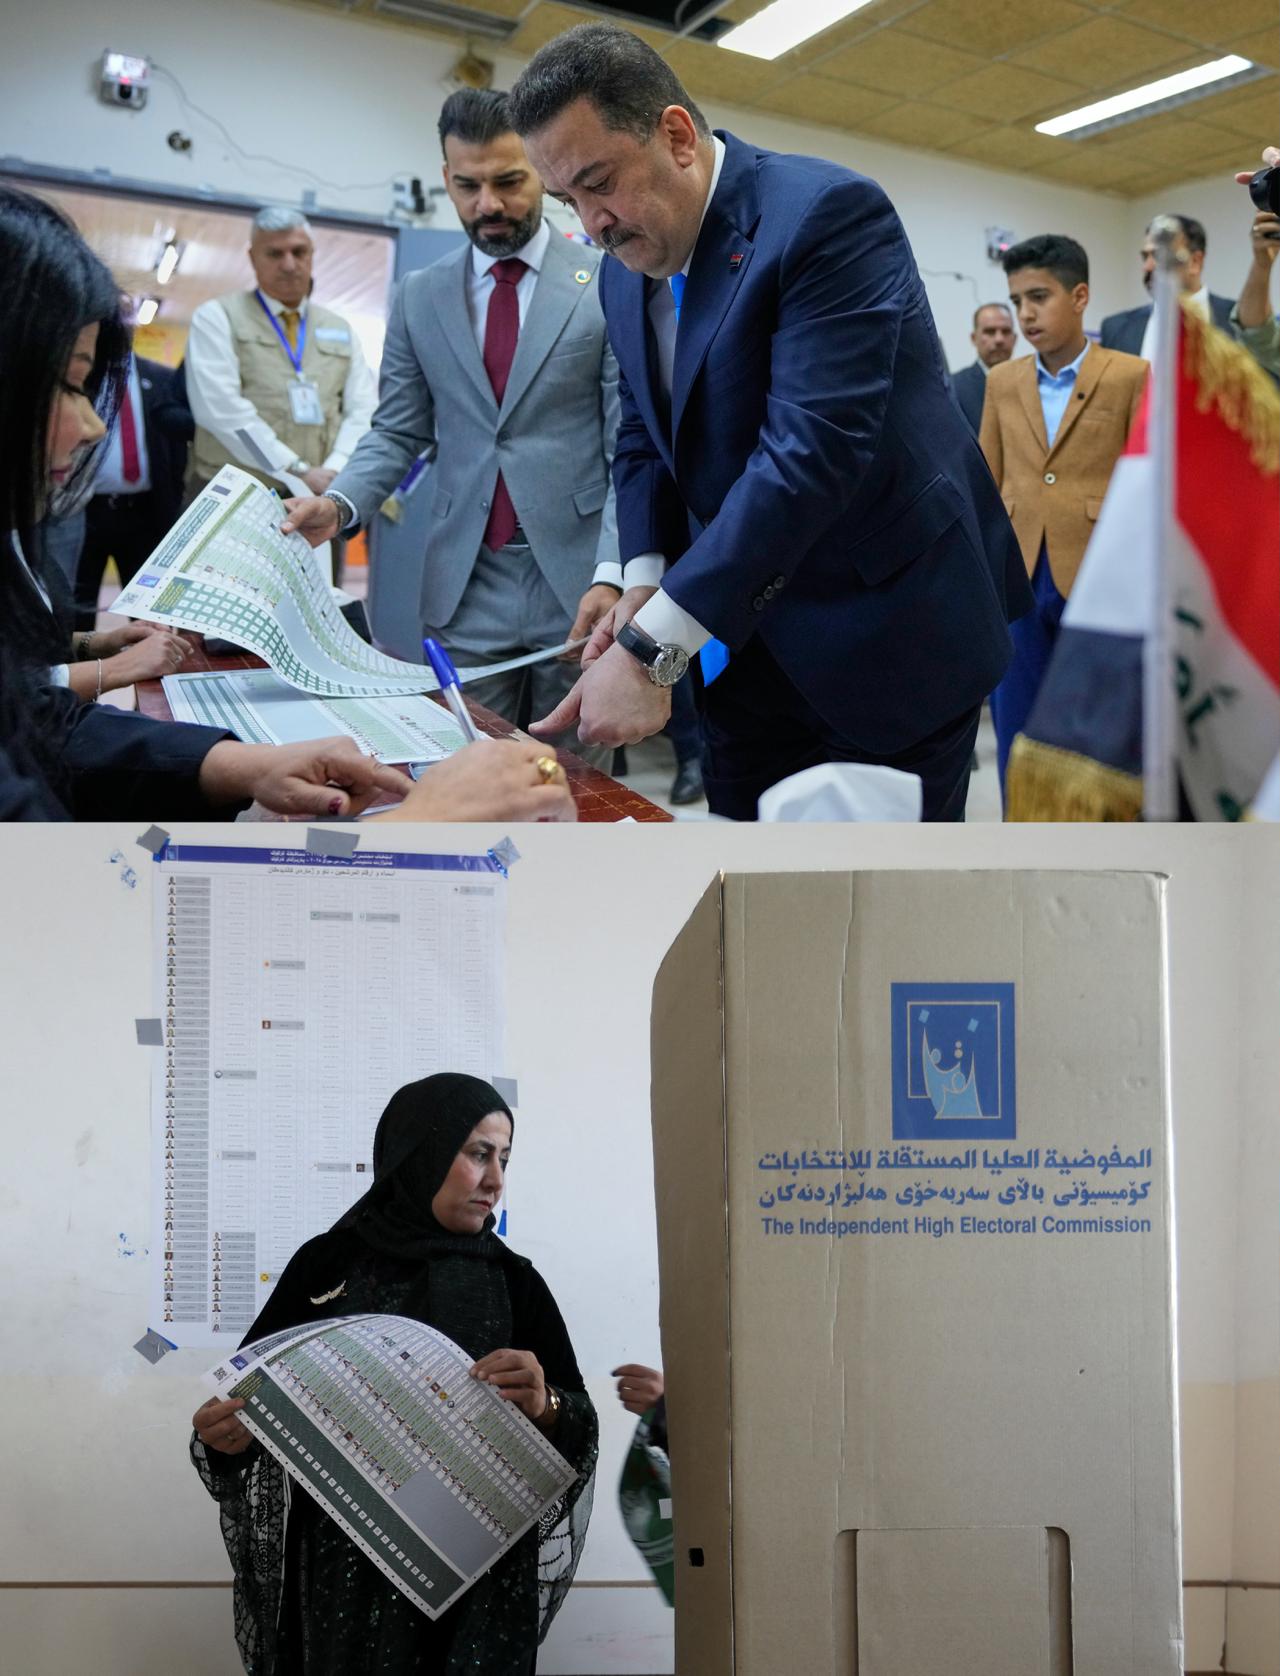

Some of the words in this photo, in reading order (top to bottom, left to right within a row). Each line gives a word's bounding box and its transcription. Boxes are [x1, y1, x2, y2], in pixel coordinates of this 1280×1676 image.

[758, 1149, 872, 1176] للانتخابات
[877, 1145, 977, 1170] المستقلة
[982, 1148, 1039, 1176] العليا
[1044, 1145, 1152, 1175] المفوضية
[761, 1218, 794, 1235] The
[799, 1217, 910, 1238] Independent
[913, 1216, 954, 1238] High
[959, 1216, 1037, 1234] Electoral
[1041, 1215, 1152, 1234] Commission
